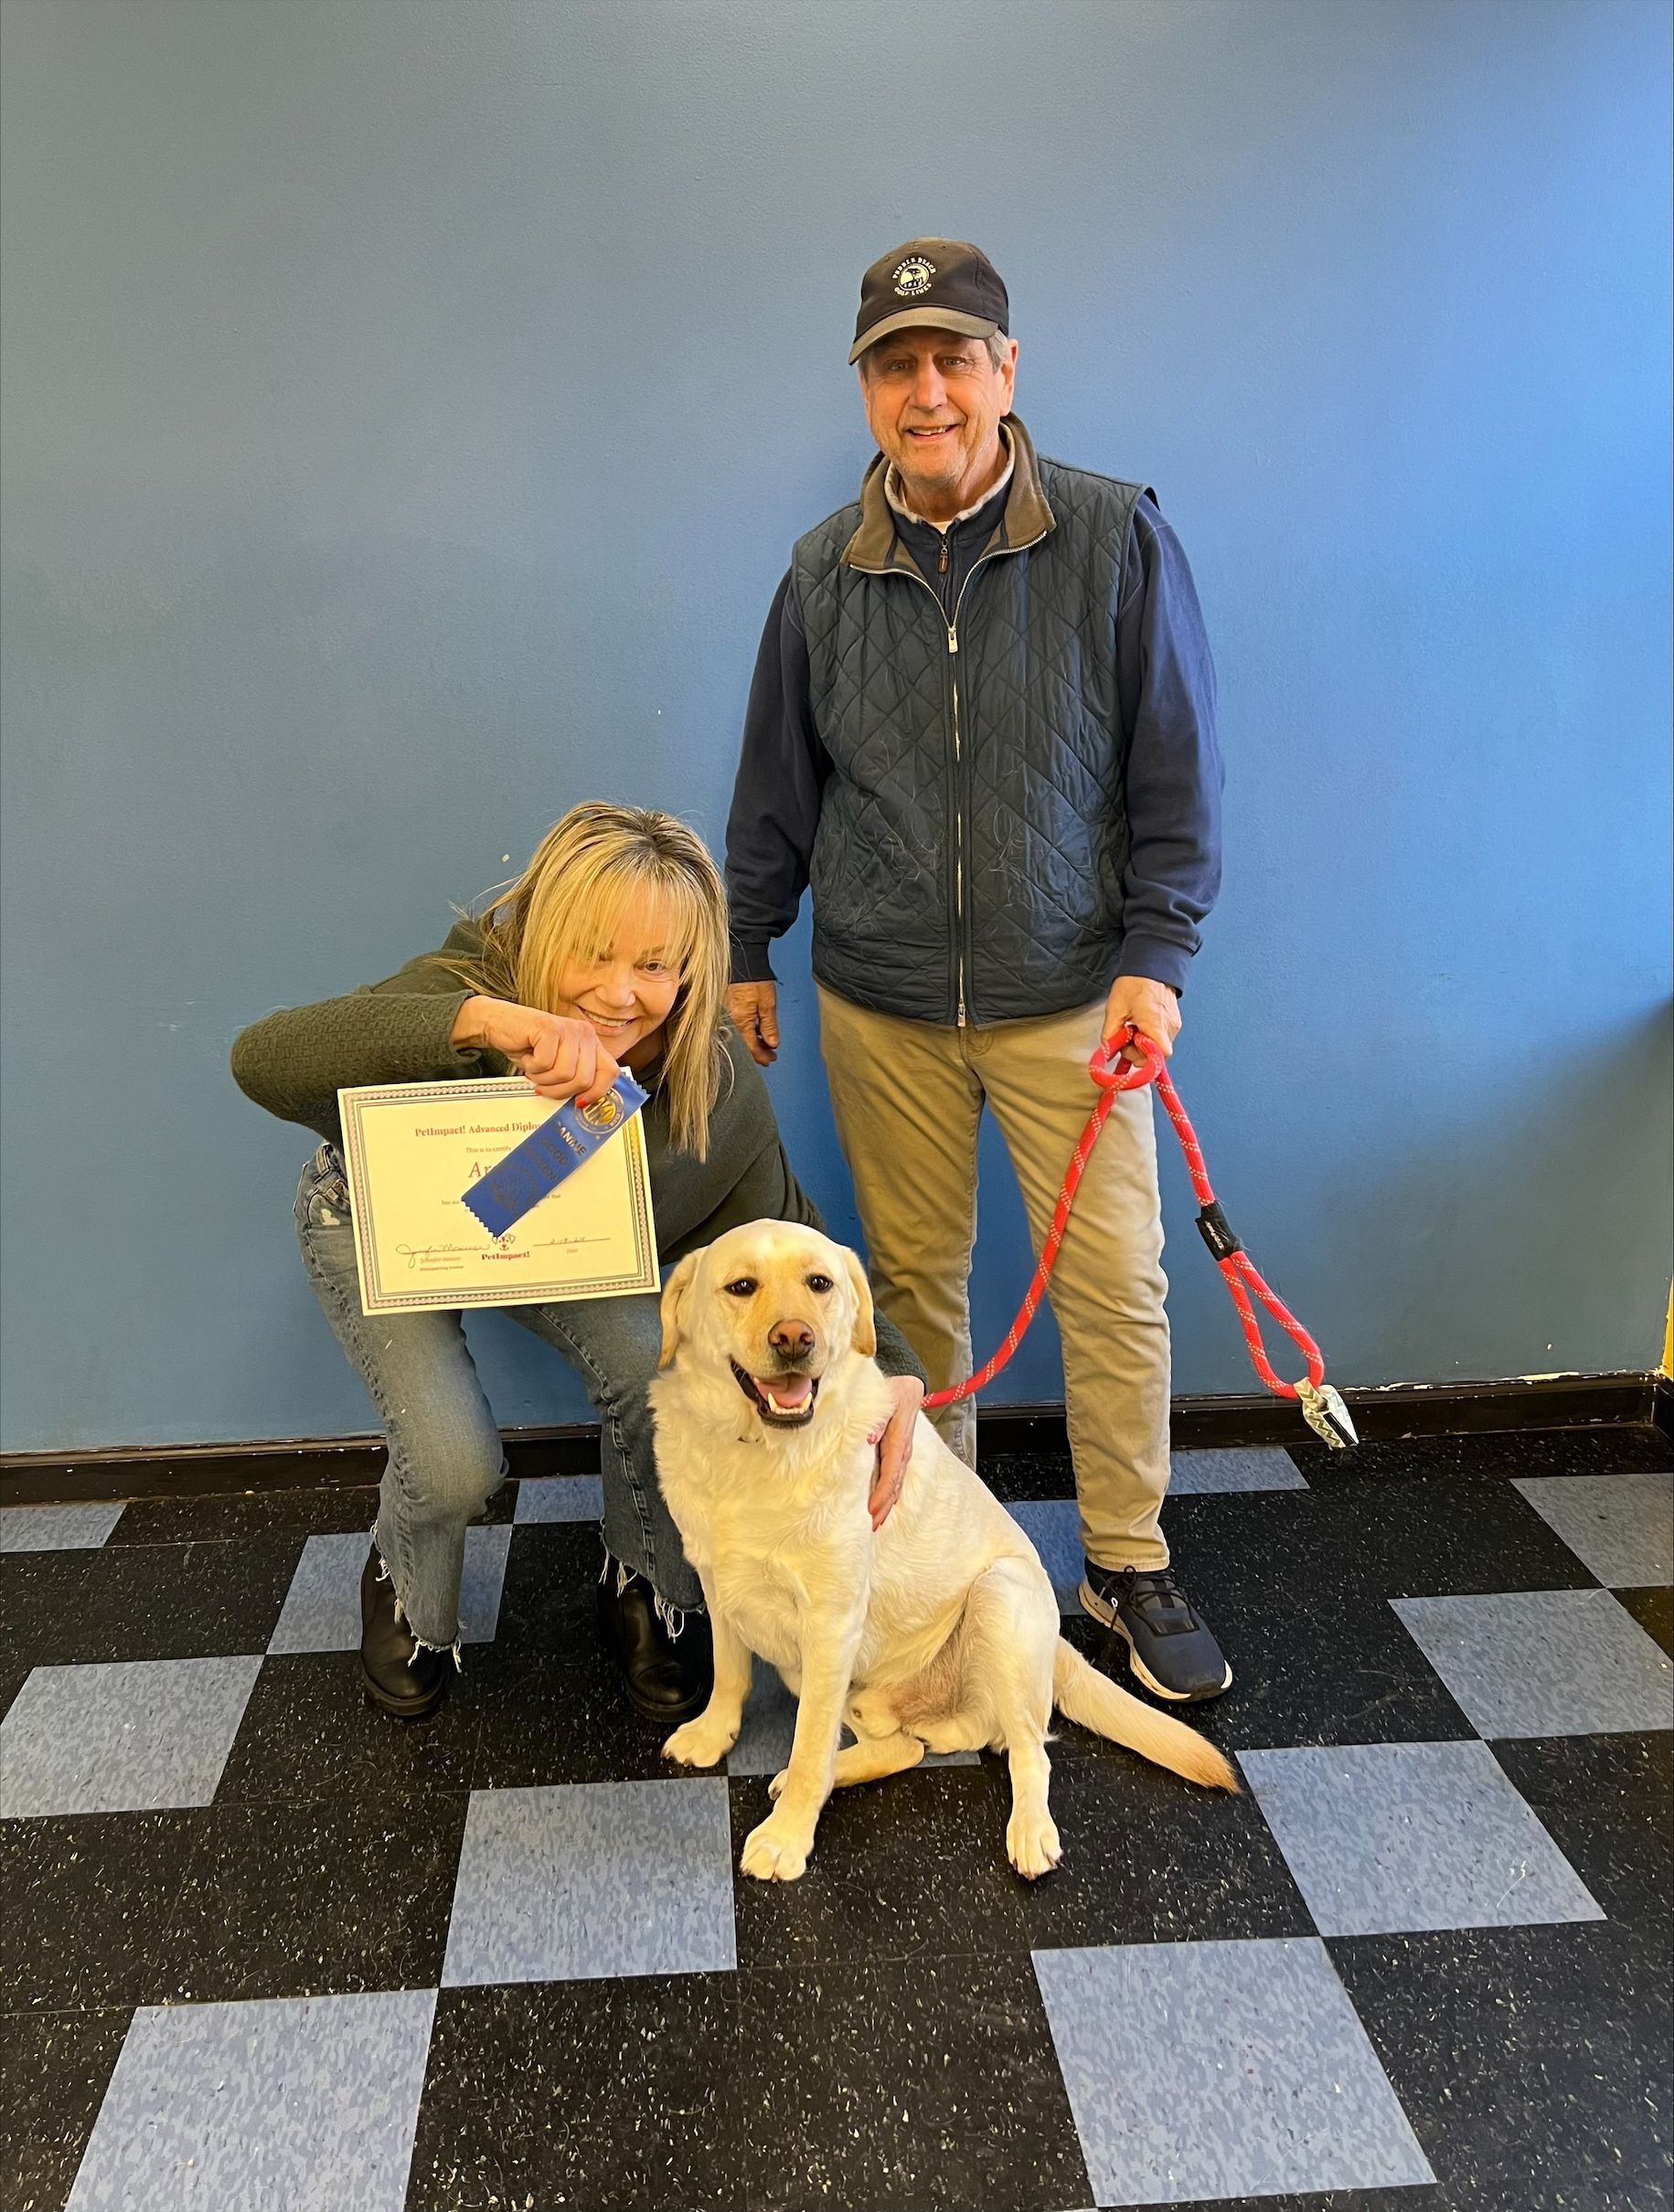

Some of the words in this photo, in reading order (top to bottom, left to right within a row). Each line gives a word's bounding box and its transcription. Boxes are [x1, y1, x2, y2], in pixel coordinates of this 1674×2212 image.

[415, 1125, 465, 1137] PetImpact!
[468, 1123, 509, 1133] Advanced
[482, 1251, 530, 1260] PetImpact!
